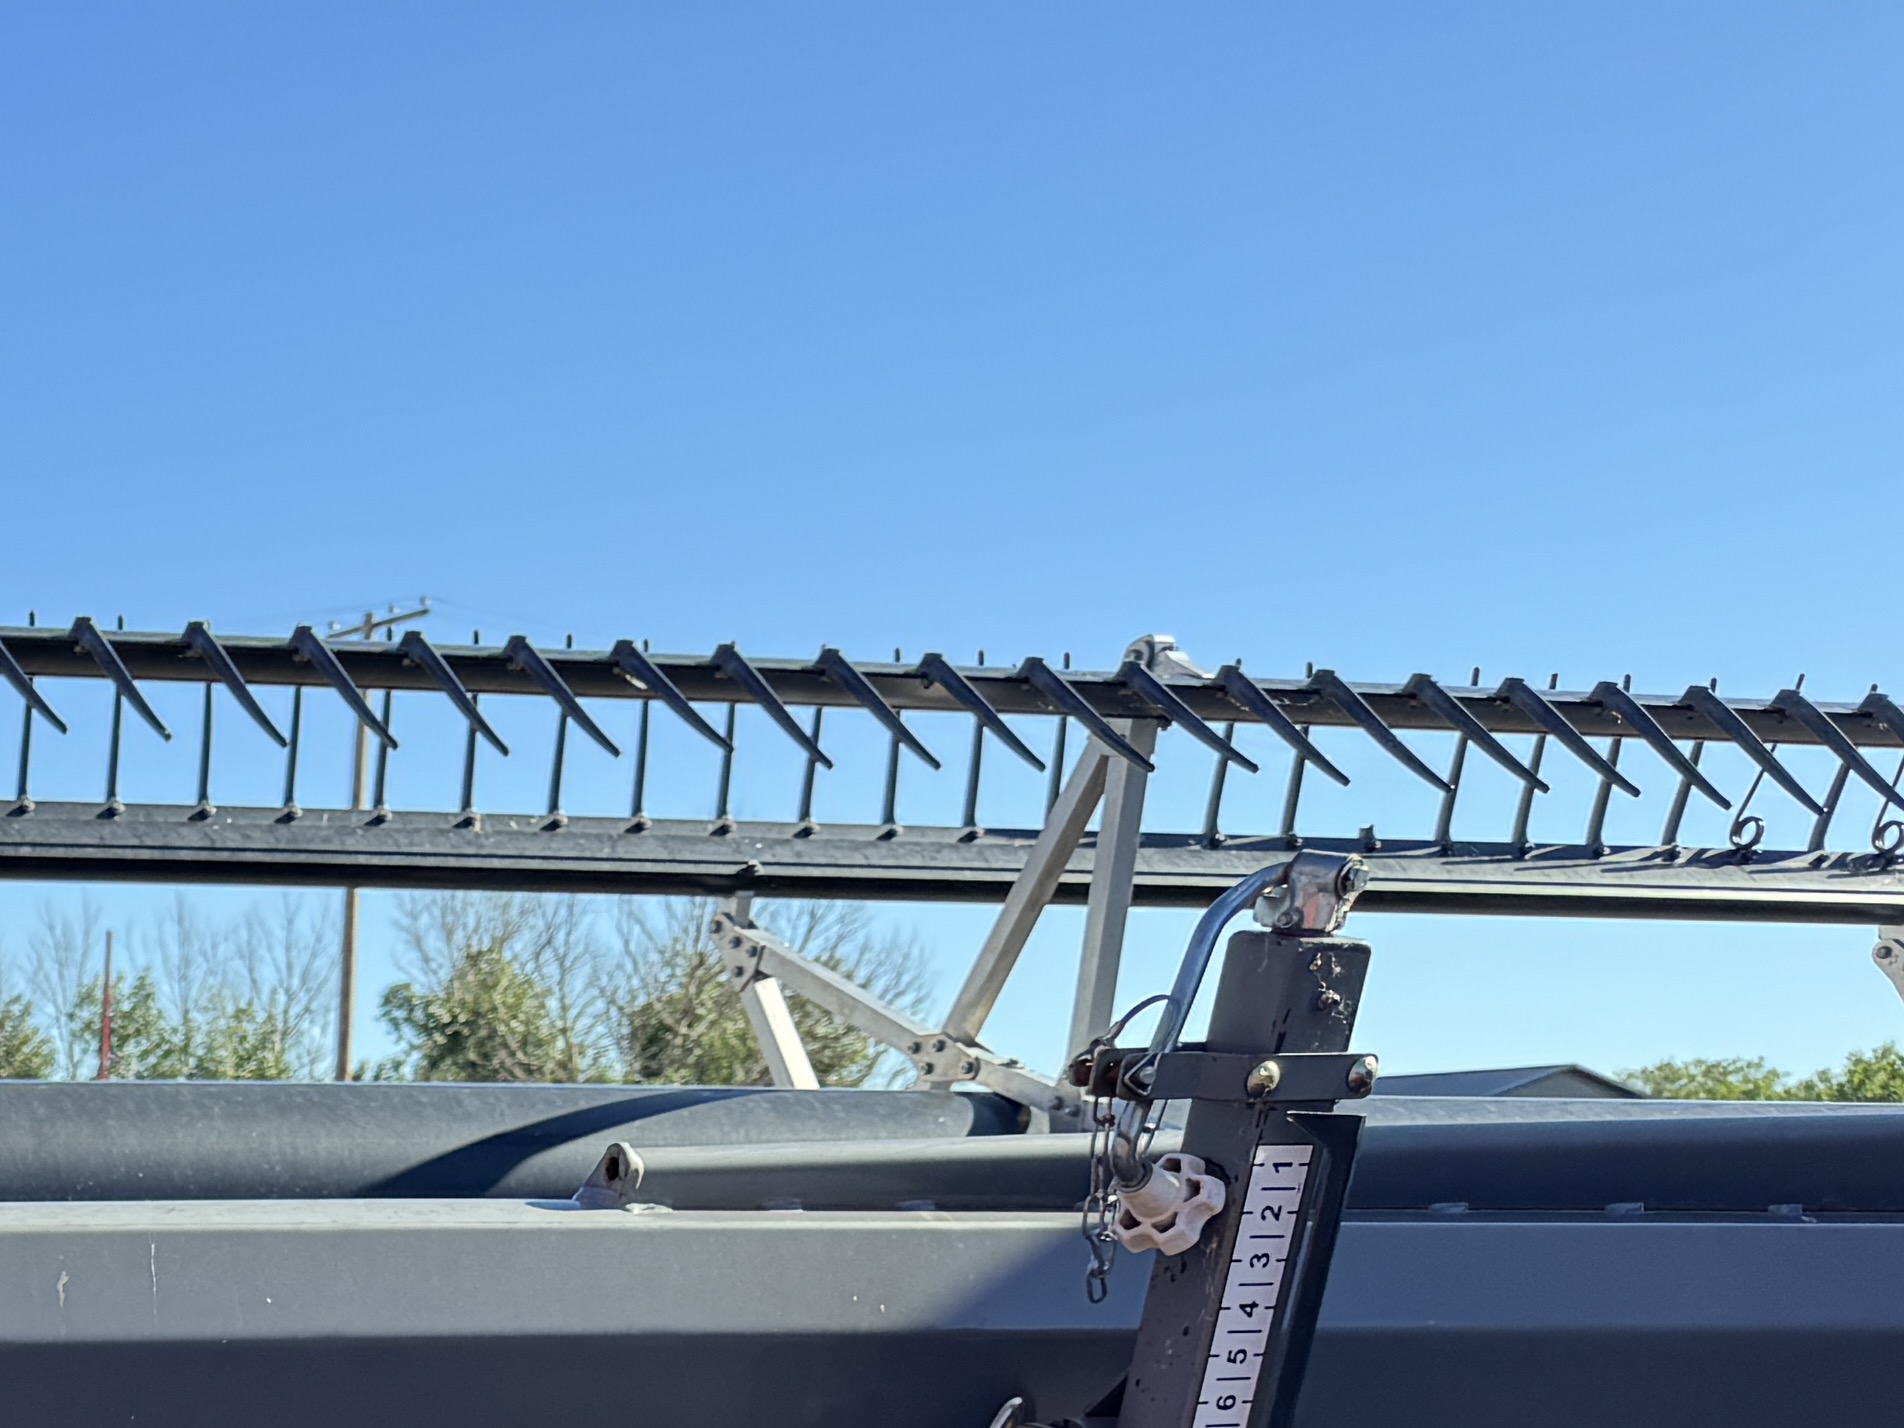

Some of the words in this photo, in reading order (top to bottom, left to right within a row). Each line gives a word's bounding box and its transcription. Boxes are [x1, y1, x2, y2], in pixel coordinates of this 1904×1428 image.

[1216, 1394, 1236, 1411] 6
[1227, 1348, 1248, 1364] 5
[1239, 1301, 1259, 1318] 4
[1249, 1252, 1270, 1268] 3
[1260, 1204, 1282, 1221] 2
[1272, 1161, 1293, 1173] 1
